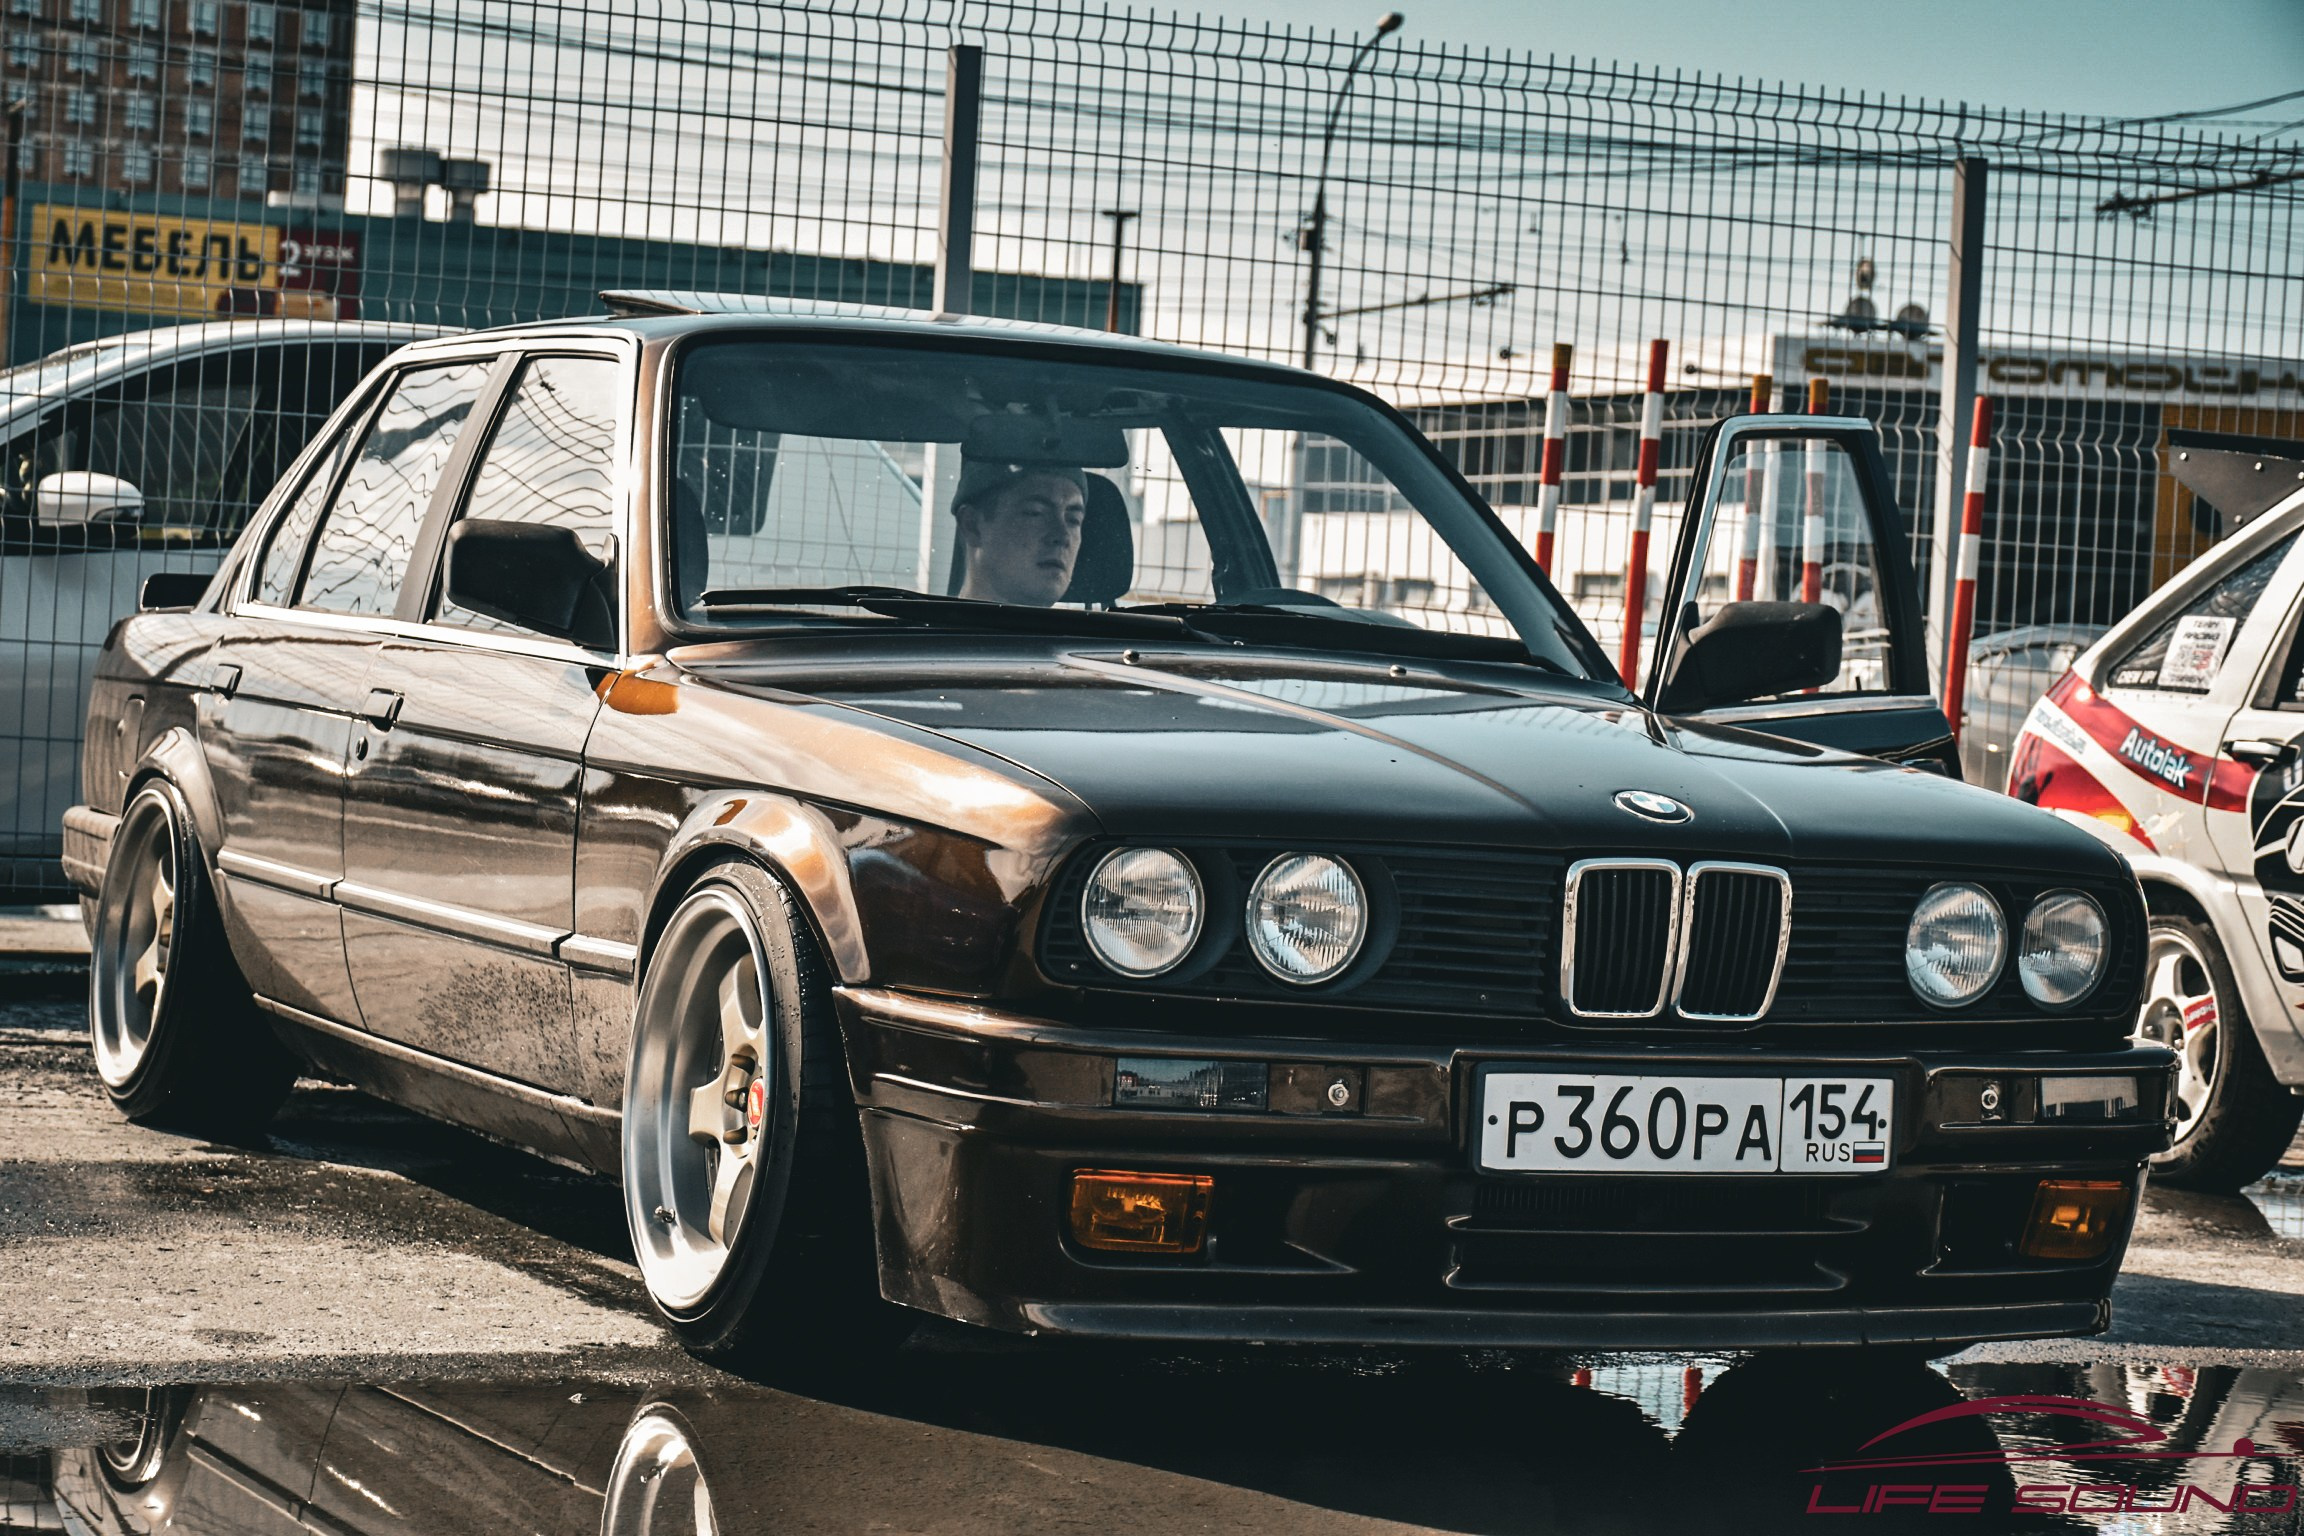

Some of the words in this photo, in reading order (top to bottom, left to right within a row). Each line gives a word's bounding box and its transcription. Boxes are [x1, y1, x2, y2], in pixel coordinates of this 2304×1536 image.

[49, 217, 265, 281] МЕБЕЛЬ
[279, 239, 302, 277] 2
[2119, 725, 2193, 789] Autolak
[1506, 1084, 1772, 1161] Р360РА
[1789, 1083, 1878, 1140] 154
[1805, 1142, 1850, 1162] RUS
